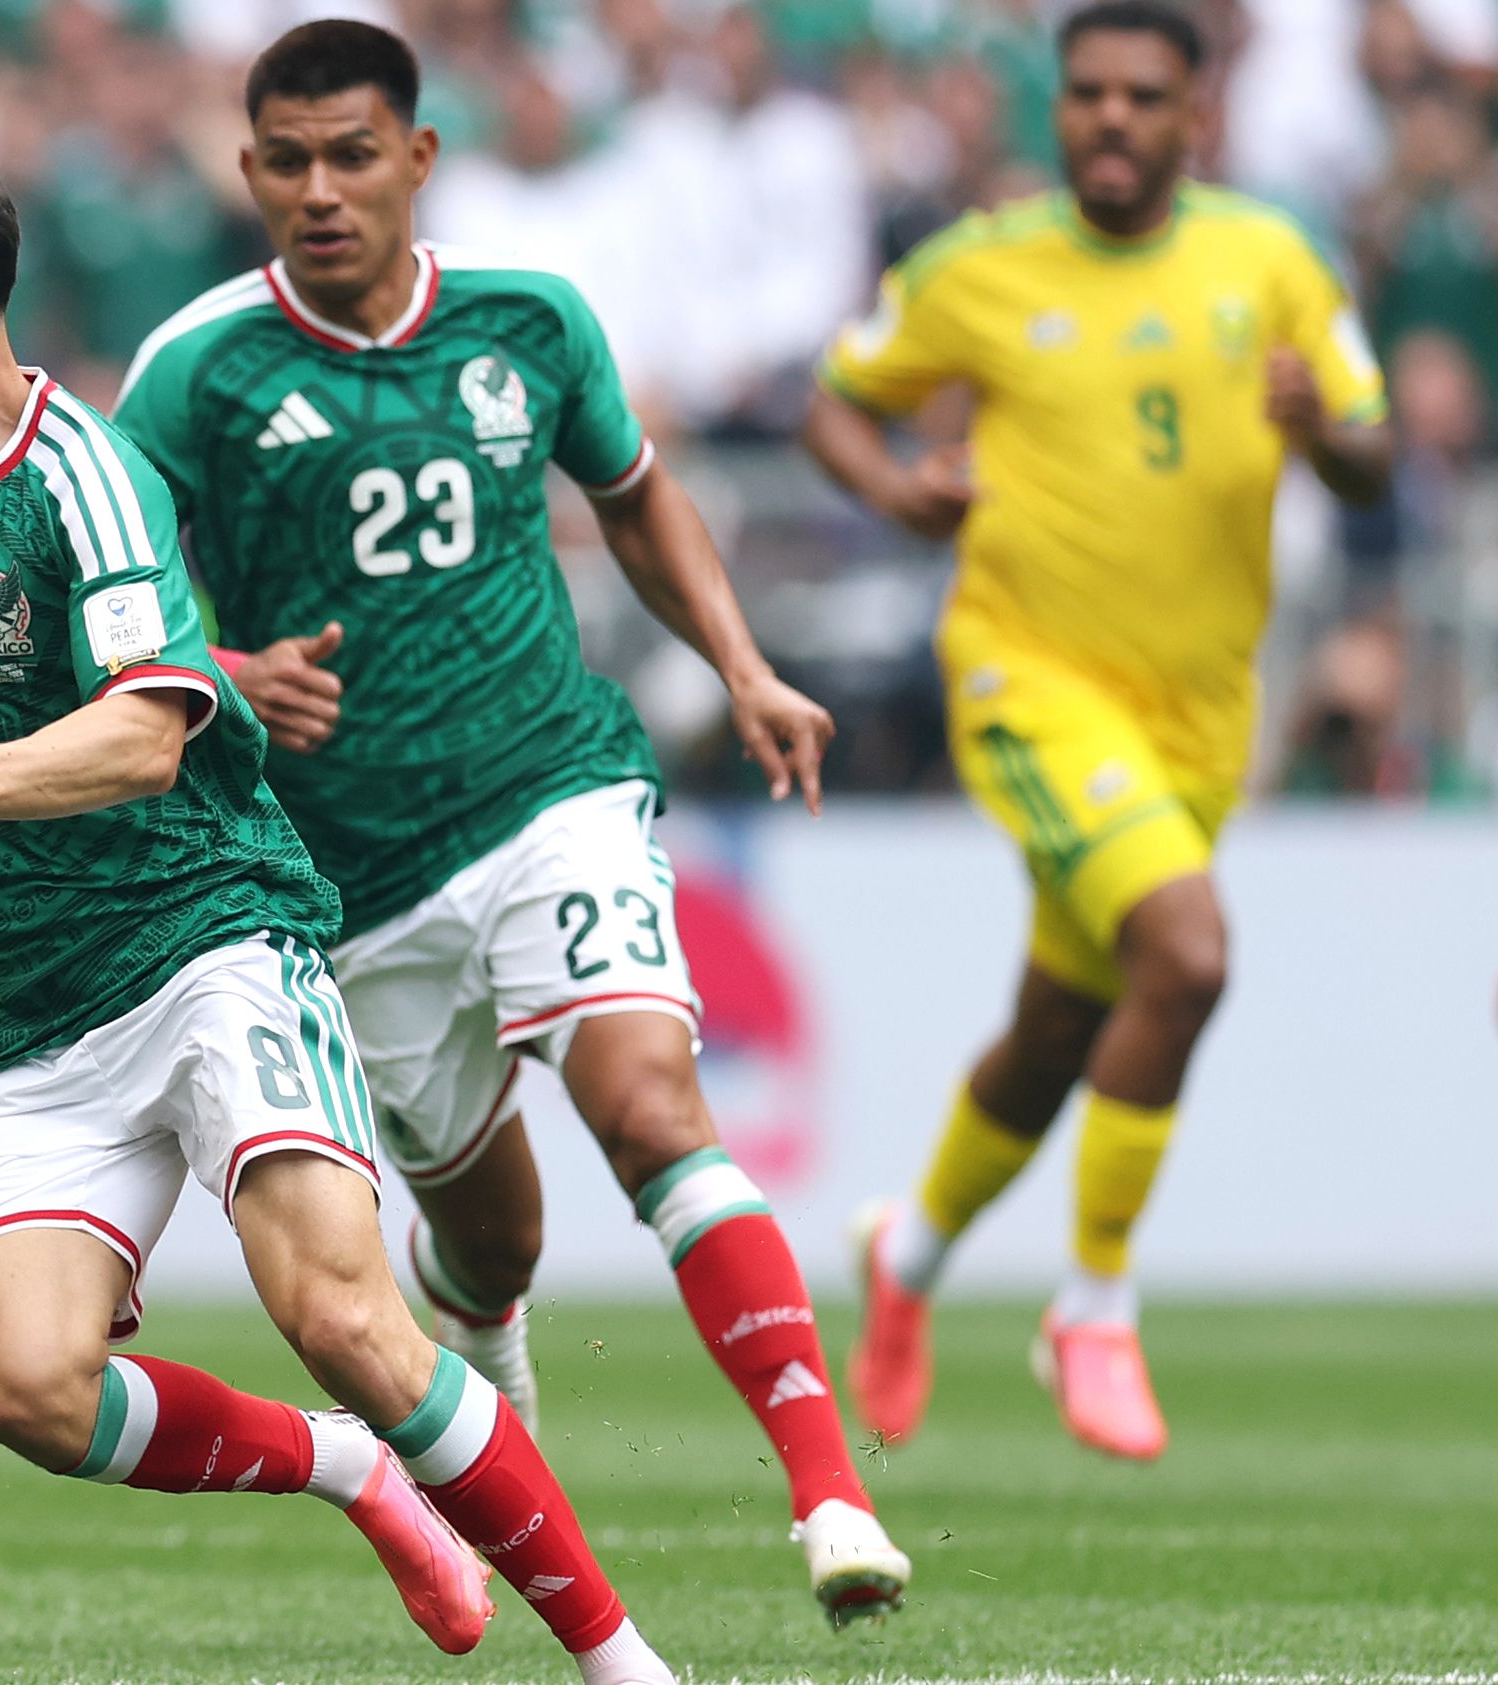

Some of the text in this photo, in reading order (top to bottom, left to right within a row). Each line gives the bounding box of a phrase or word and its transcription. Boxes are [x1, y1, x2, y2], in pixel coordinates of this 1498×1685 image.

[1135, 385, 1184, 472] 9
[349, 457, 477, 577] 23
[110, 625, 143, 643] PEACE
[557, 888, 669, 980] 23
[247, 1024, 313, 1110] 8
[476, 1512, 544, 1555] ÉXICO
